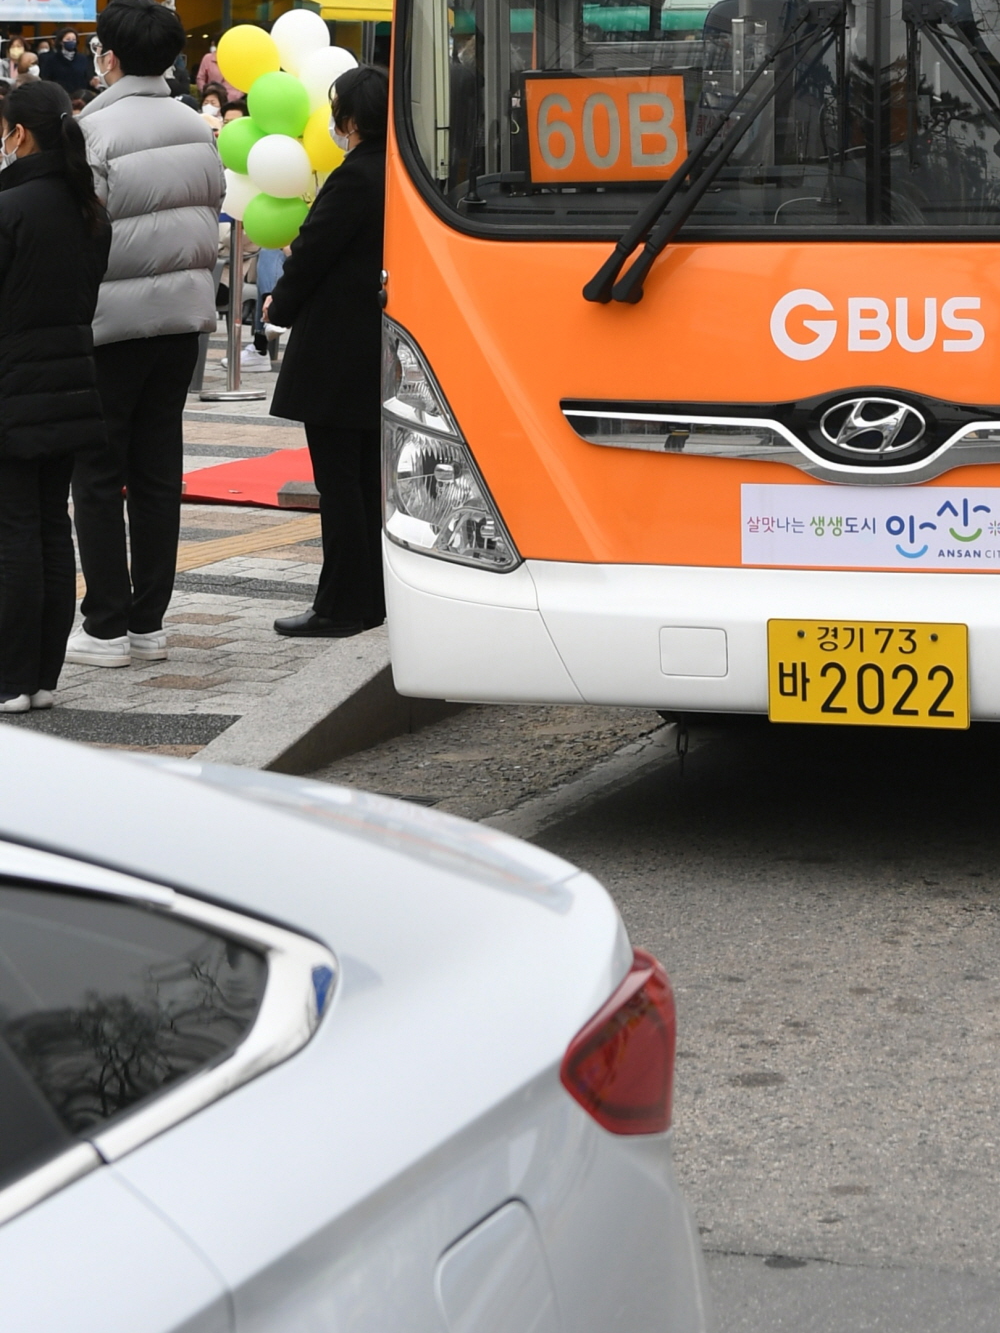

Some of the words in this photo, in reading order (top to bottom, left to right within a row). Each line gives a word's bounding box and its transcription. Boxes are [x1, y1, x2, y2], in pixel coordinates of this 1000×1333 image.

[536, 92, 679, 171] 60B
[746, 515, 805, 535] 살맛나는
[809, 515, 876, 537] 생생도시
[937, 549, 982, 559] ANSAN
